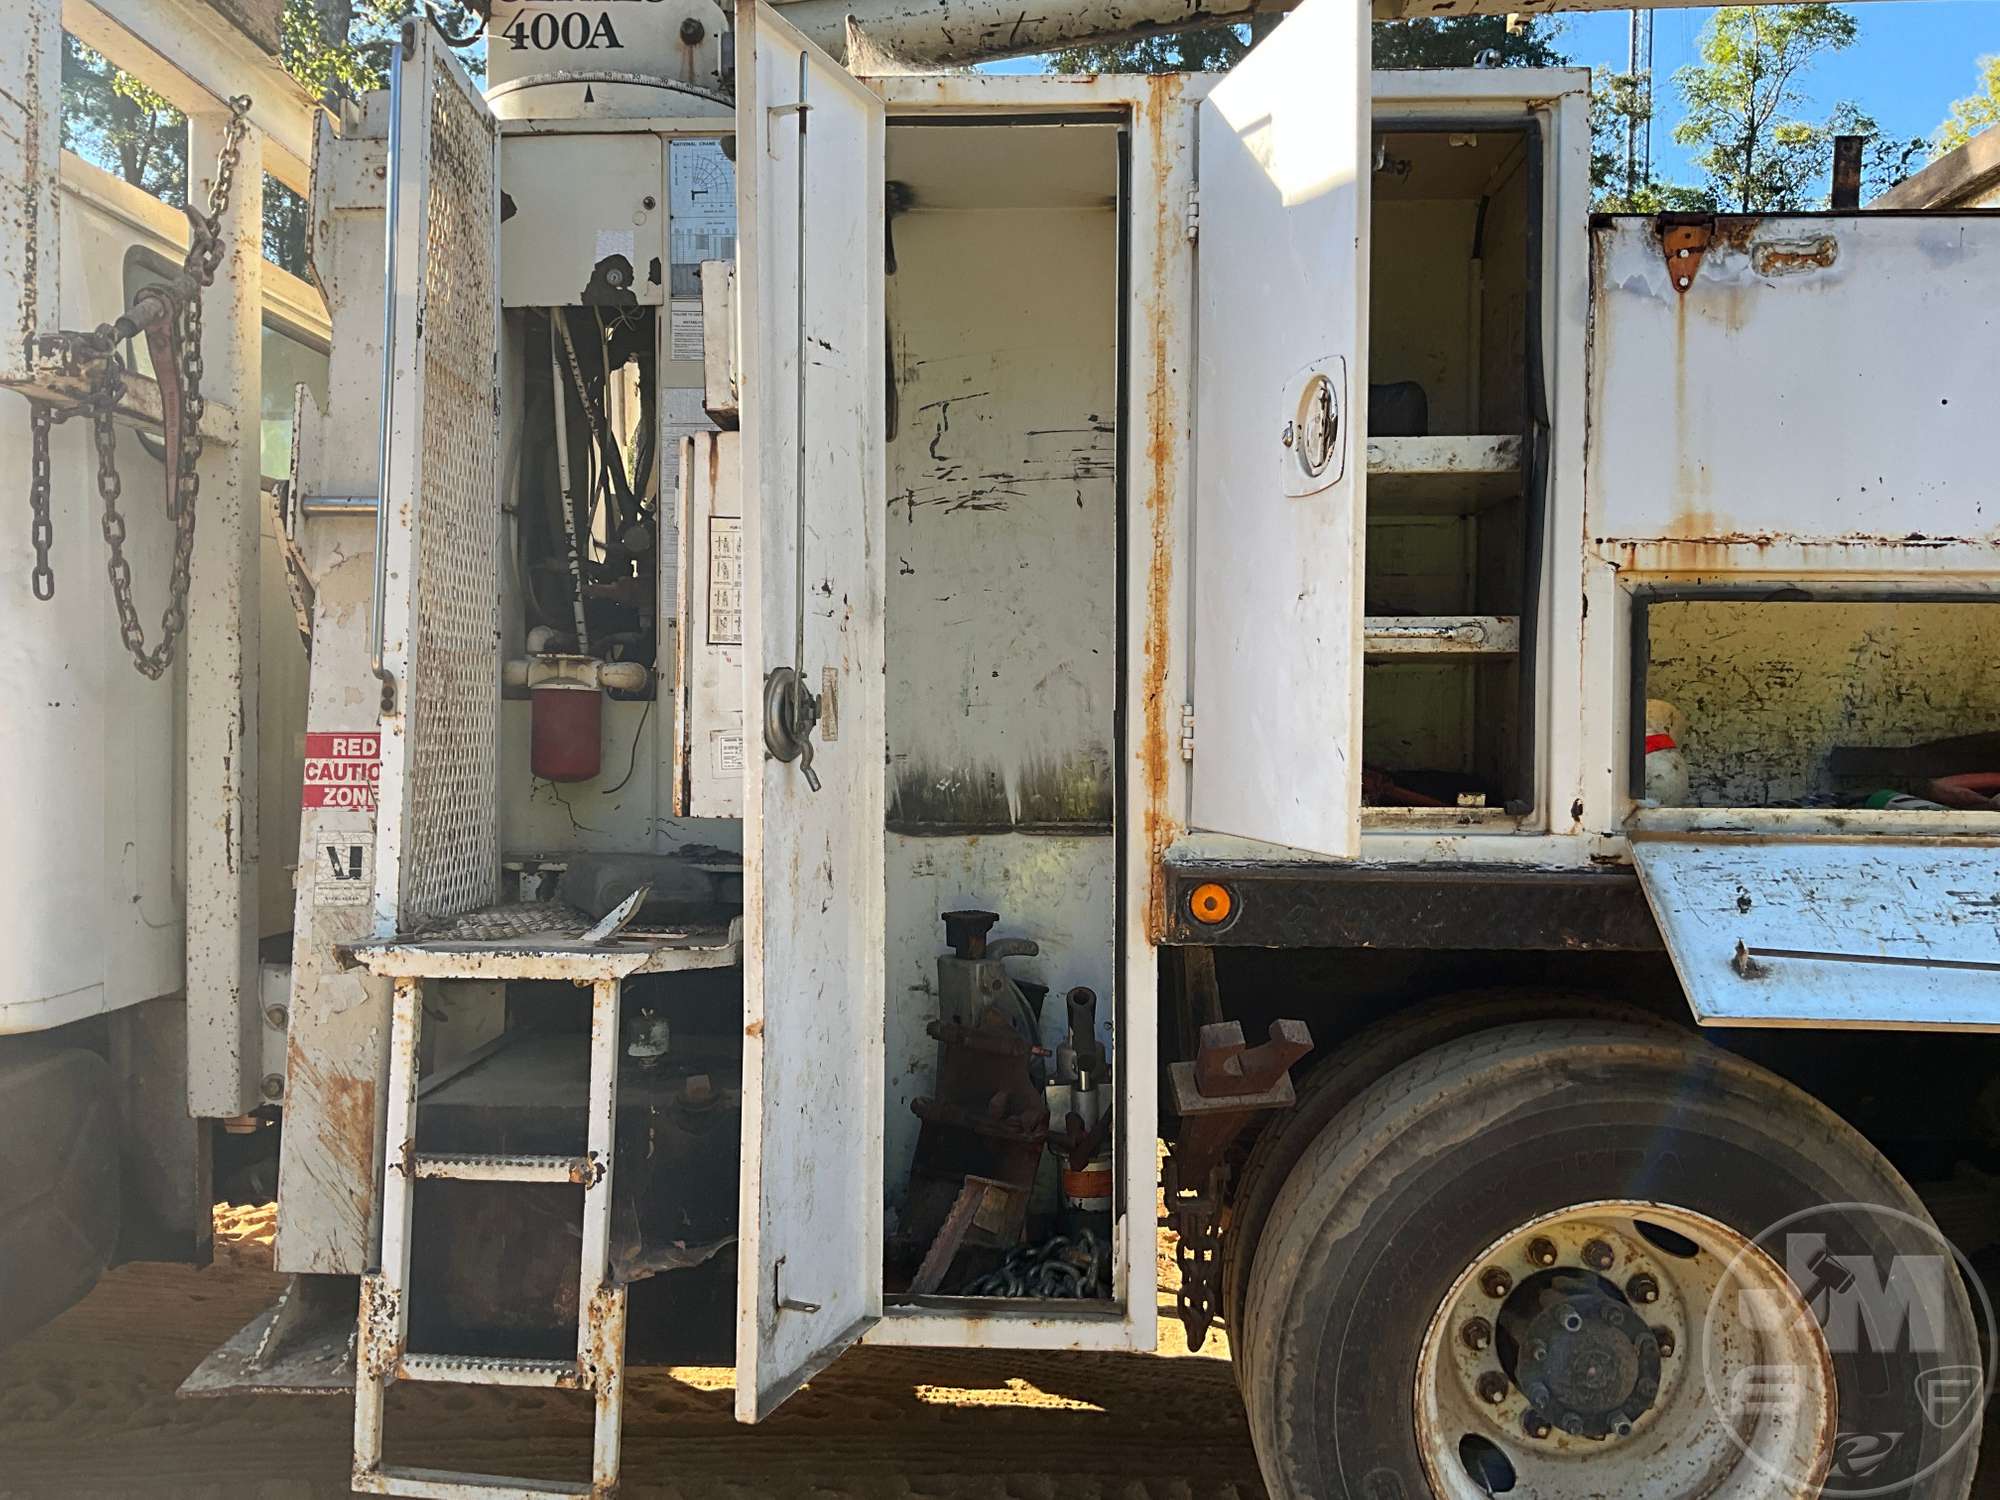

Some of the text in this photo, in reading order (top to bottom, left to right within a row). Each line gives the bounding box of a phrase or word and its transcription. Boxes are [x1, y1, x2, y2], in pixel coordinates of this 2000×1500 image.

[502, 8, 624, 50] 400A
[333, 738, 377, 756] RED
[305, 762, 380, 781] CAUTIO
[323, 787, 379, 806] ZONE
